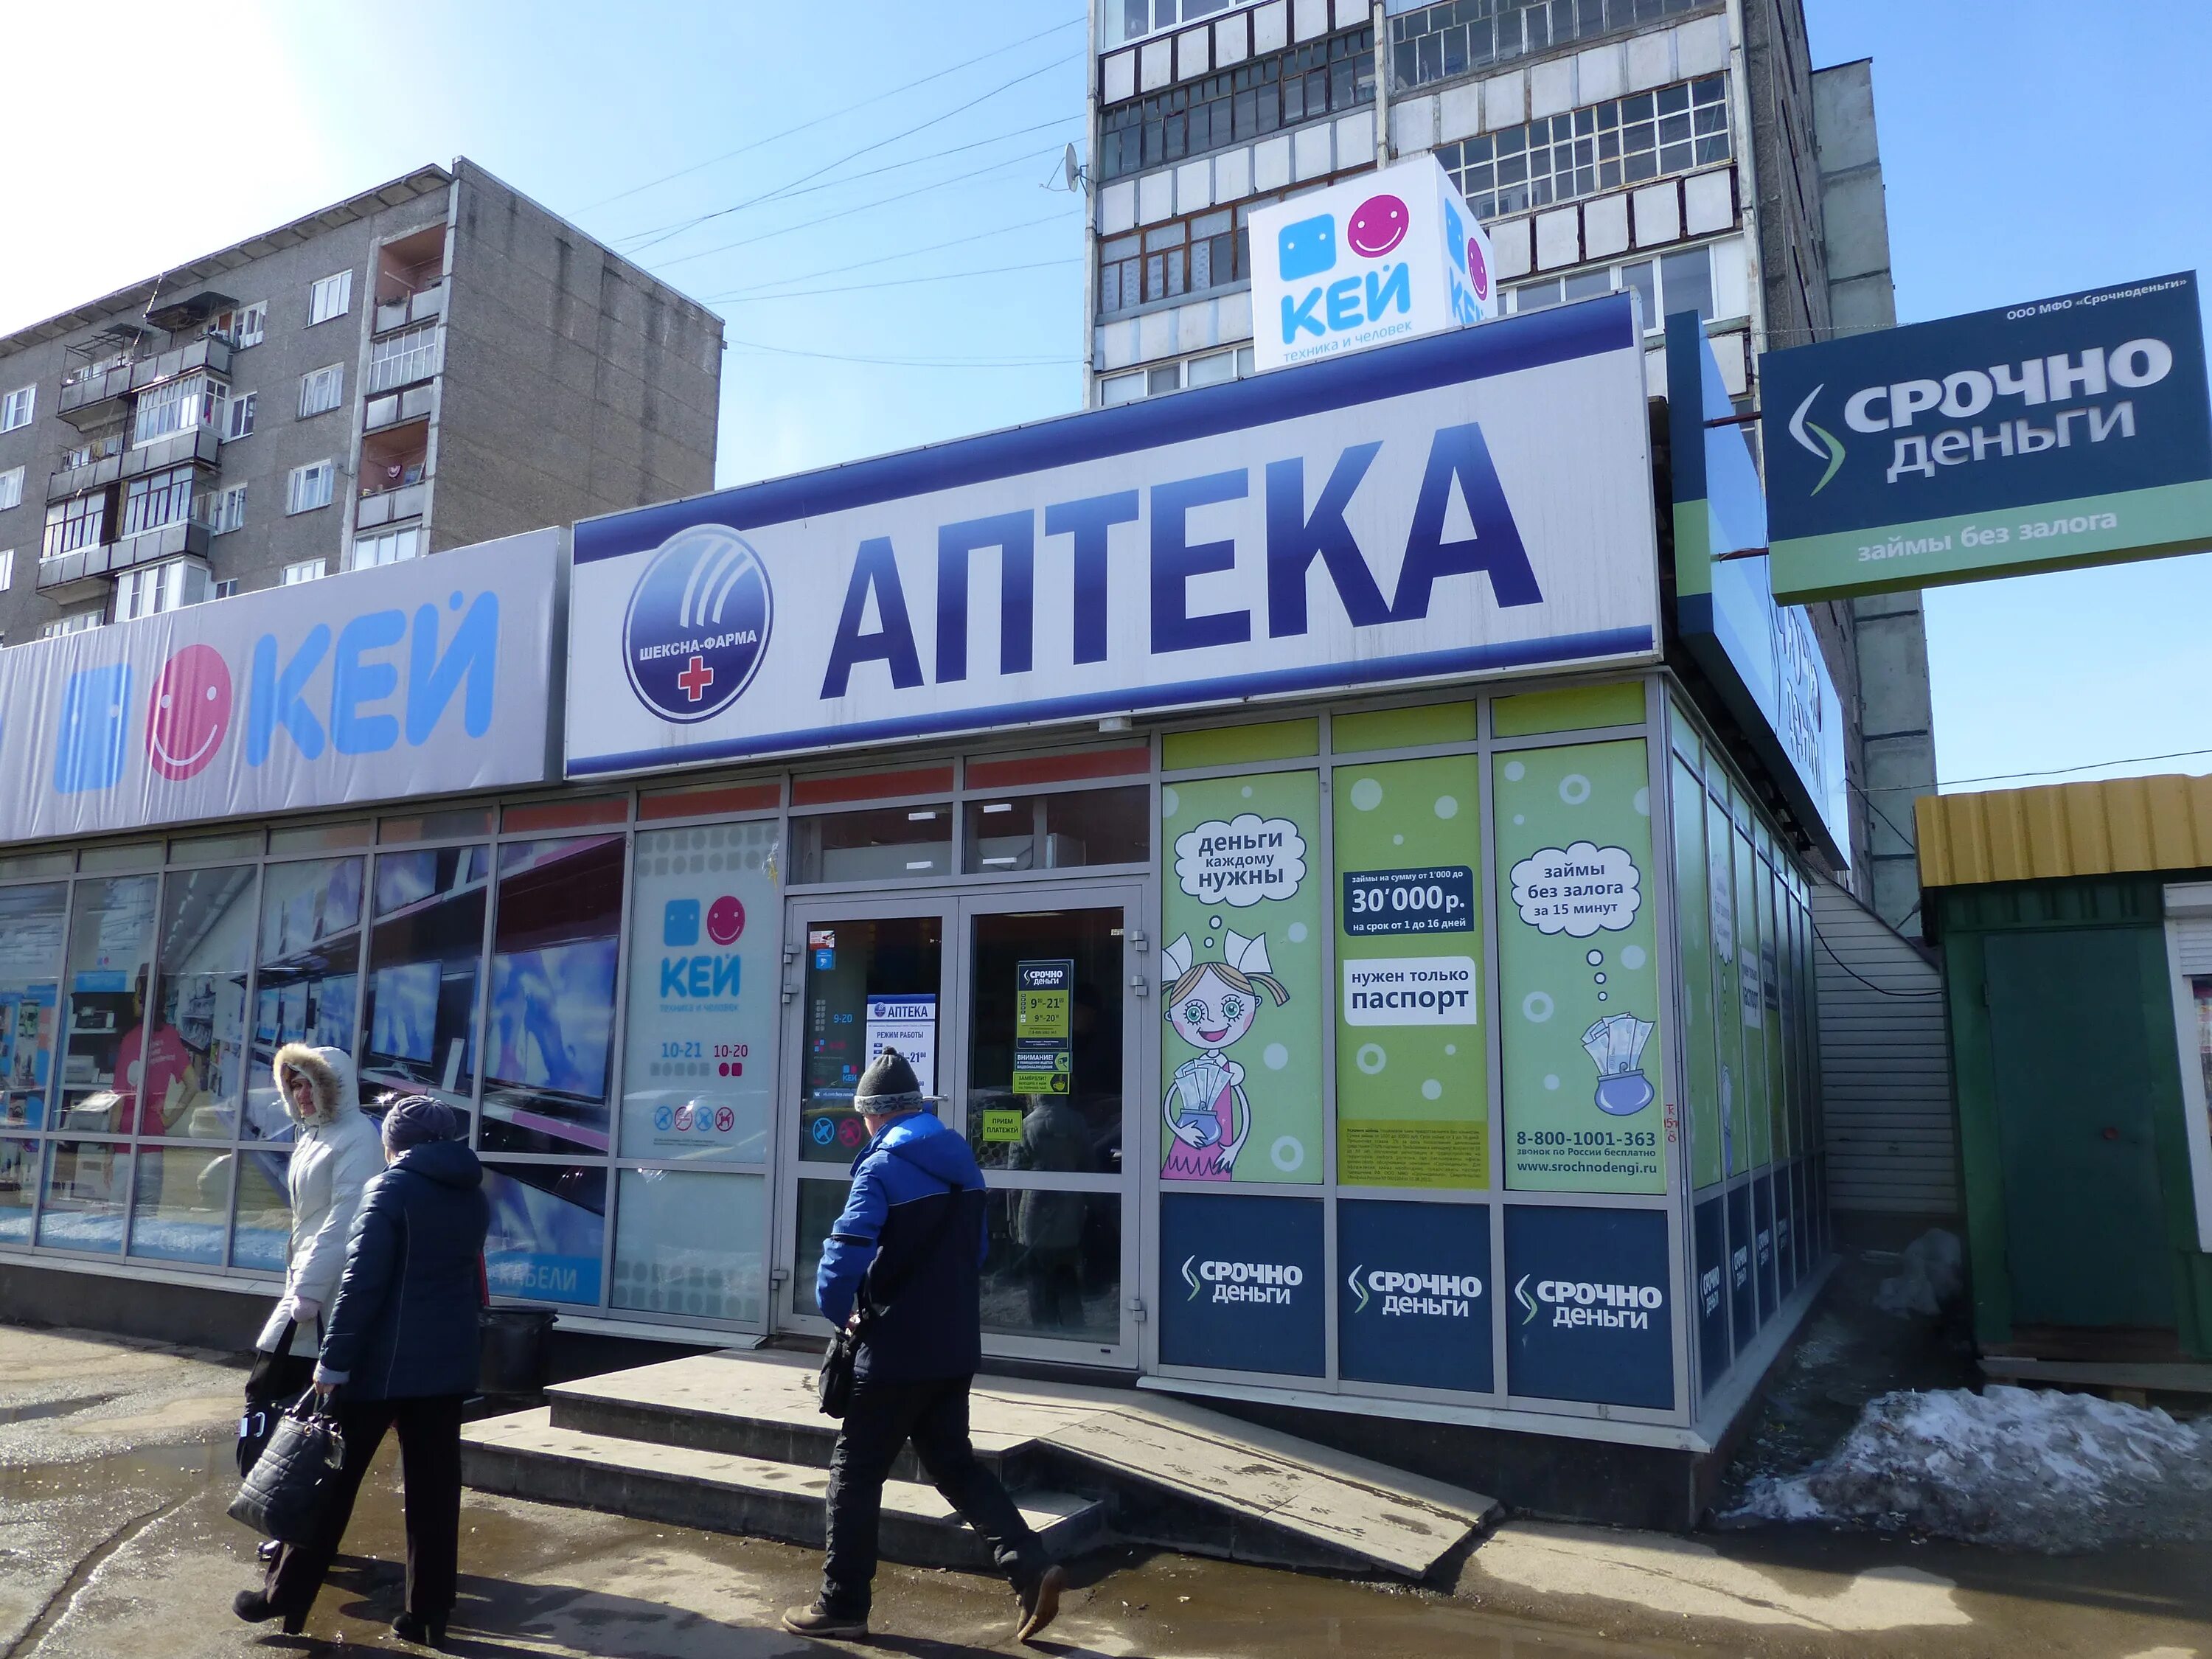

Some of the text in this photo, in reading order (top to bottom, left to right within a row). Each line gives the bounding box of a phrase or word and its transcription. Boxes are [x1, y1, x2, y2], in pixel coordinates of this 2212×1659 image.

[1281, 262, 1411, 345] КЕЙ
[2007, 280, 2187, 320] ООО МФО «Срочноденьги»
[1284, 321, 1412, 363] техника и человек
[1845, 338, 2172, 433] СРОЧНО
[1887, 400, 2135, 484] деньги
[1858, 512, 2118, 563] займы без залога
[819, 422, 1543, 700] АПТЕКА
[639, 630, 757, 661] ШЕКСНА-ФАРМА
[246, 591, 499, 768] КЕЙ
[1198, 832, 1283, 858] деньги
[1206, 855, 1275, 869] каждому
[1544, 862, 1605, 878] займы
[1199, 869, 1284, 893] нужны
[1391, 874, 1416, 883] сумму
[1429, 871, 1451, 879] 1'000
[1528, 883, 1624, 899] без залога
[1534, 903, 1618, 916] за 15 минут
[1366, 922, 1389, 933] срок
[1391, 922, 1402, 930] от
[1404, 921, 1411, 929] 1
[1412, 921, 1425, 931] до
[1427, 919, 1439, 928] 16
[1441, 918, 1467, 929] дней
[660, 953, 741, 998] КЕЙ
[1029, 970, 1063, 978] СРОЧНО
[1033, 978, 1060, 986] деньги
[1352, 970, 1469, 987] нужен только
[887, 1006, 928, 1018] АПТЕКА
[1352, 990, 1469, 1015] паспорт
[662, 1042, 702, 1058] 10-21
[714, 1044, 748, 1057] 10-20
[1517, 1131, 1656, 1147] 8-800-1001-363
[1517, 1148, 1656, 1158] звонок по России бесплатно
[1517, 1161, 1658, 1176] www.srochnodengi.ru
[1200, 1260, 1304, 1286] СРОЧНО
[1368, 1270, 1483, 1298] СРОЧНО
[1212, 1284, 1291, 1304] деньги
[1537, 1280, 1663, 1310] СРОЧНО
[1382, 1295, 1469, 1318] деньги
[1553, 1306, 1649, 1330] деньги
